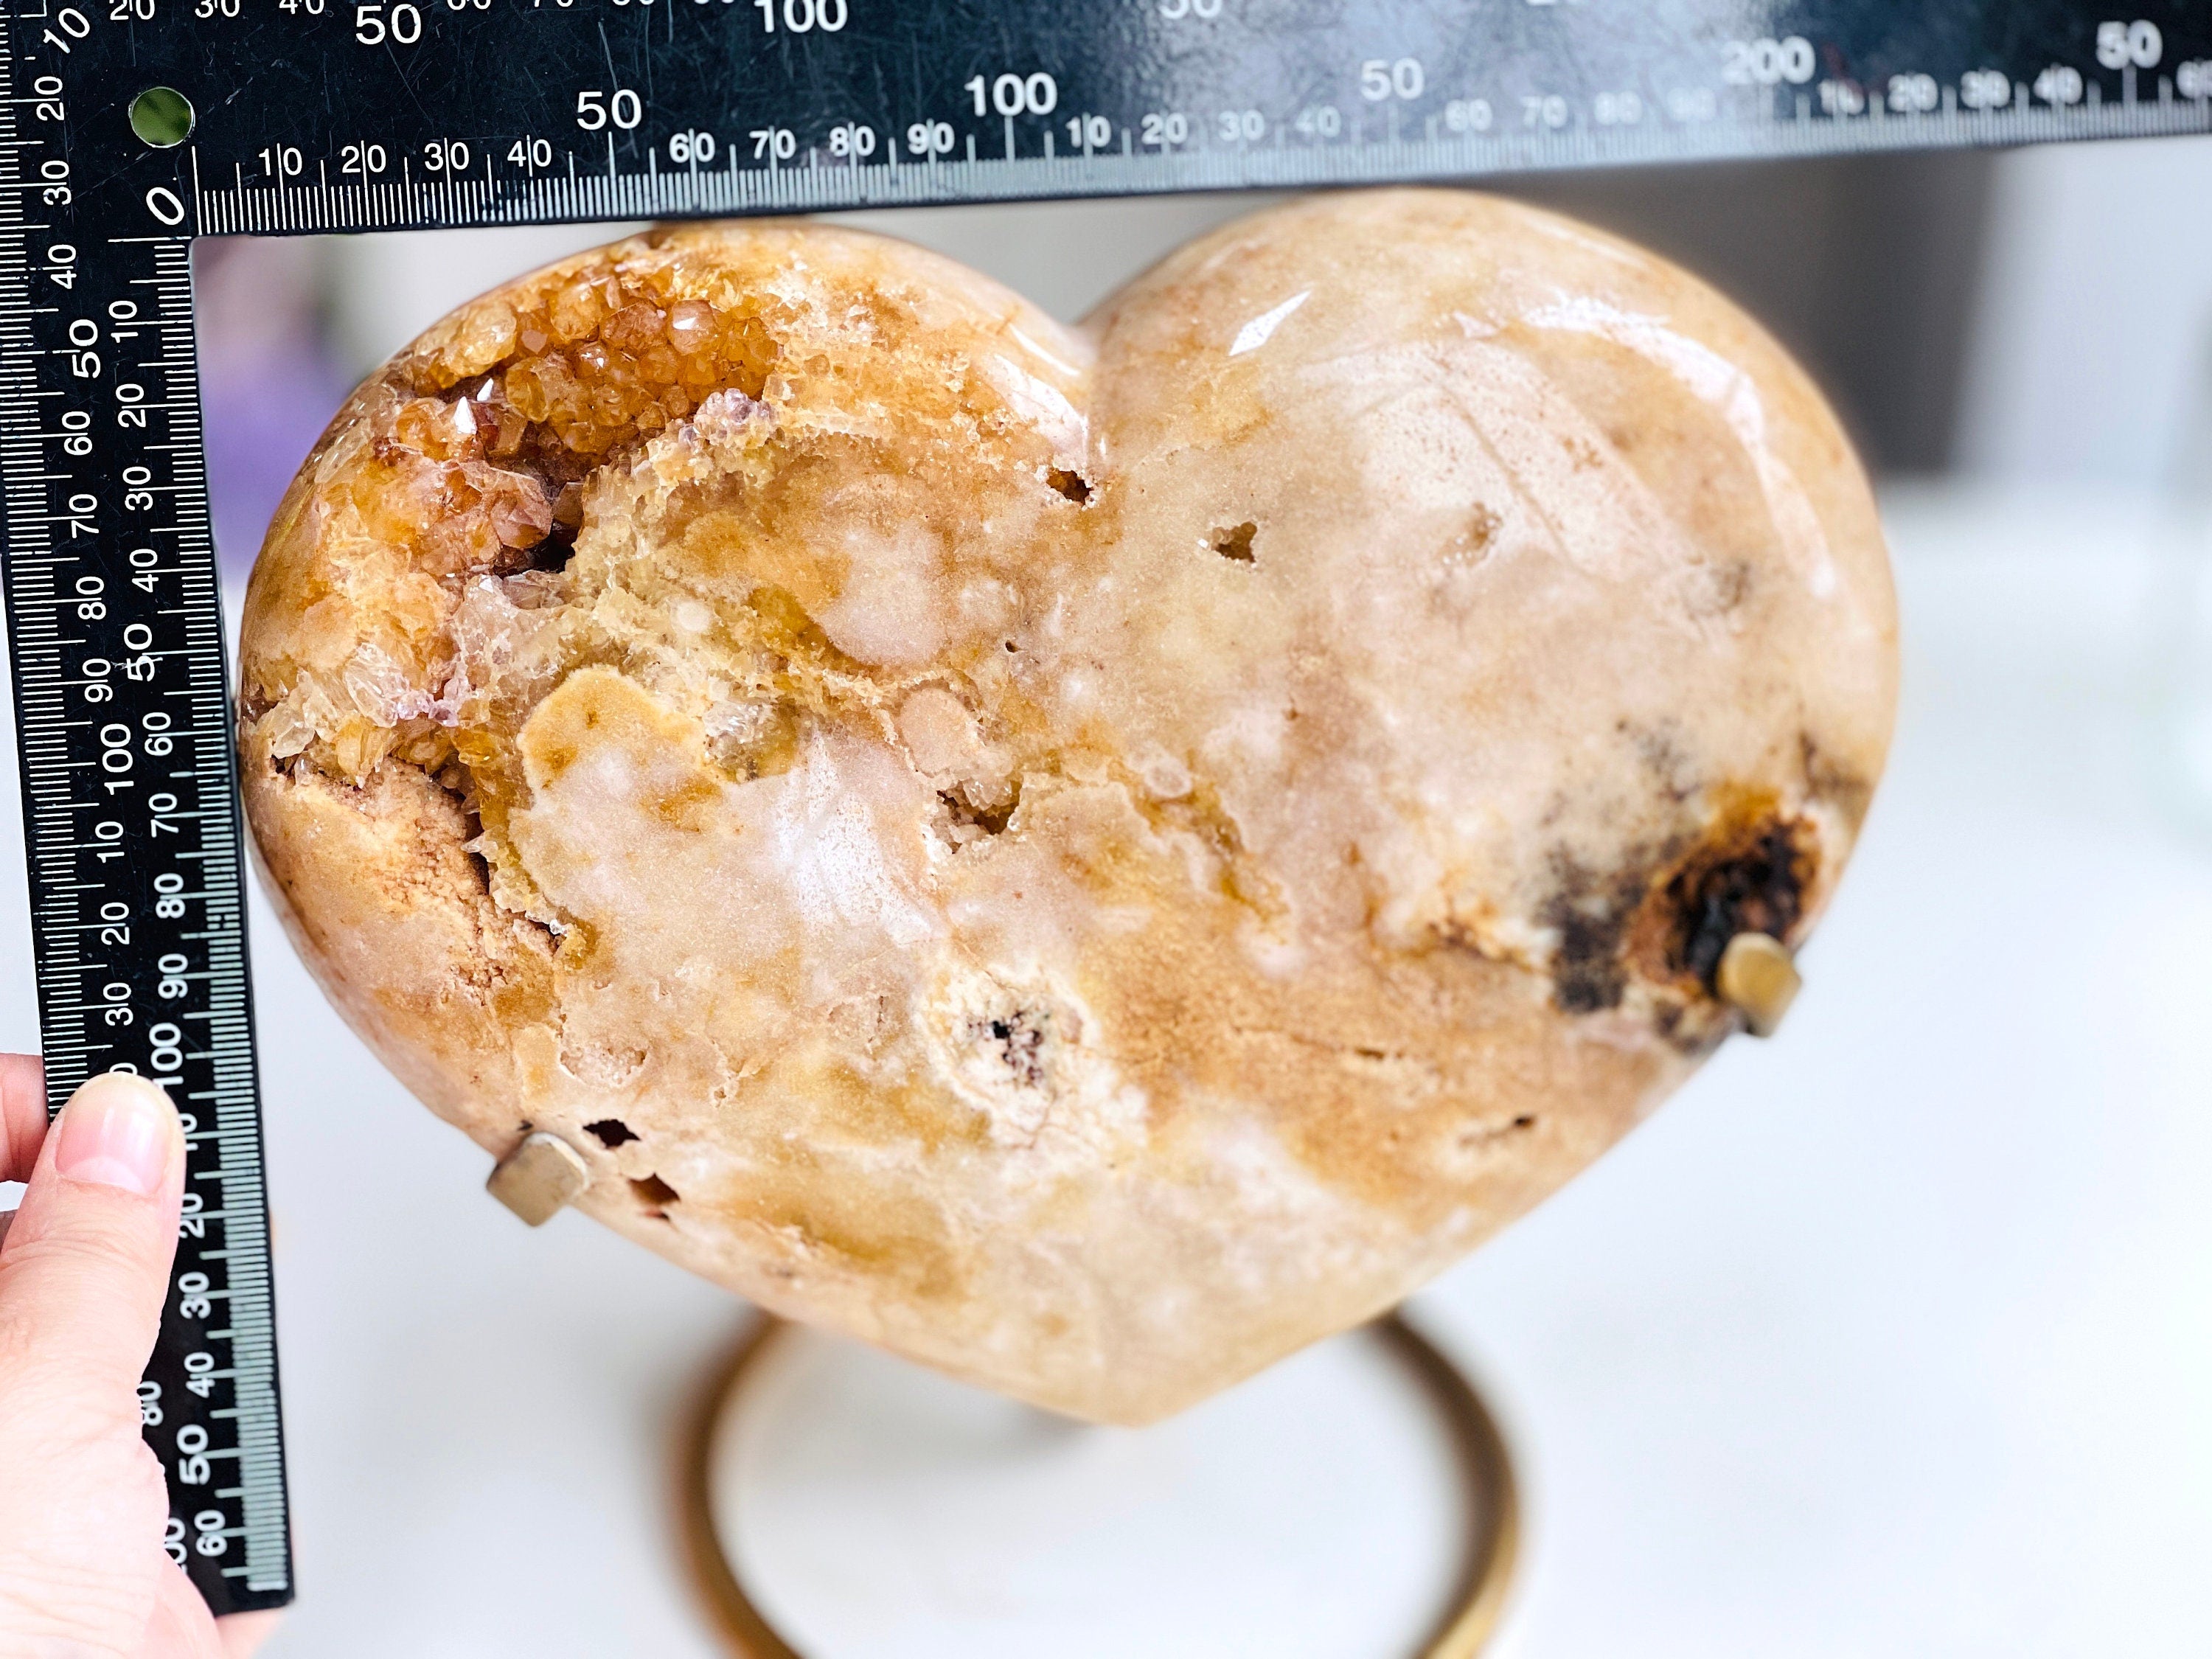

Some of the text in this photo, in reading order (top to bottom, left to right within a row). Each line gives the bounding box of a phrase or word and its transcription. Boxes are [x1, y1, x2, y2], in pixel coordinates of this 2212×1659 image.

[44, 7, 90, 54] 10
[355, 4, 421, 44] 50
[754, 0, 848, 33] 100
[35, 76, 63, 121] 20
[259, 148, 303, 176] 10
[341, 146, 386, 173] 20
[424, 142, 470, 170] 30
[507, 140, 552, 167] 40
[577, 89, 641, 130] 50
[669, 133, 716, 163] 60
[748, 129, 796, 160] 70
[829, 125, 876, 156] 80
[907, 122, 955, 153] 90
[964, 72, 1057, 116] 100
[1066, 116, 1111, 147] 10
[1141, 114, 1188, 145] 20
[1218, 111, 1265, 141] 30
[1294, 105, 1341, 138] 40
[1361, 58, 1425, 100] 50
[1721, 35, 1815, 85] 200
[2096, 20, 2162, 69] 50
[42, 160, 72, 206] 30
[146, 187, 185, 226] 0
[47, 244, 77, 289] 40
[108, 301, 139, 343] 10
[69, 319, 101, 378] 50
[116, 383, 146, 428] 20
[62, 411, 93, 456] 60
[123, 466, 153, 511] 30
[69, 493, 99, 538] 70
[130, 549, 159, 593] 40
[75, 576, 106, 620] 80
[124, 623, 156, 681] 50
[82, 658, 113, 702] 90
[142, 712, 173, 757] 60
[100, 723, 135, 796] 100
[149, 793, 179, 837] 70
[94, 821, 125, 863] 10
[154, 873, 186, 919] 80
[100, 902, 131, 946] 20
[158, 953, 188, 998] 90
[103, 982, 133, 1026] 30
[149, 1023, 184, 1090] 100
[178, 1271, 212, 1319] 30
[184, 1352, 215, 1398] 40
[176, 1425, 210, 1485] 50
[194, 1509, 228, 1557] 60
